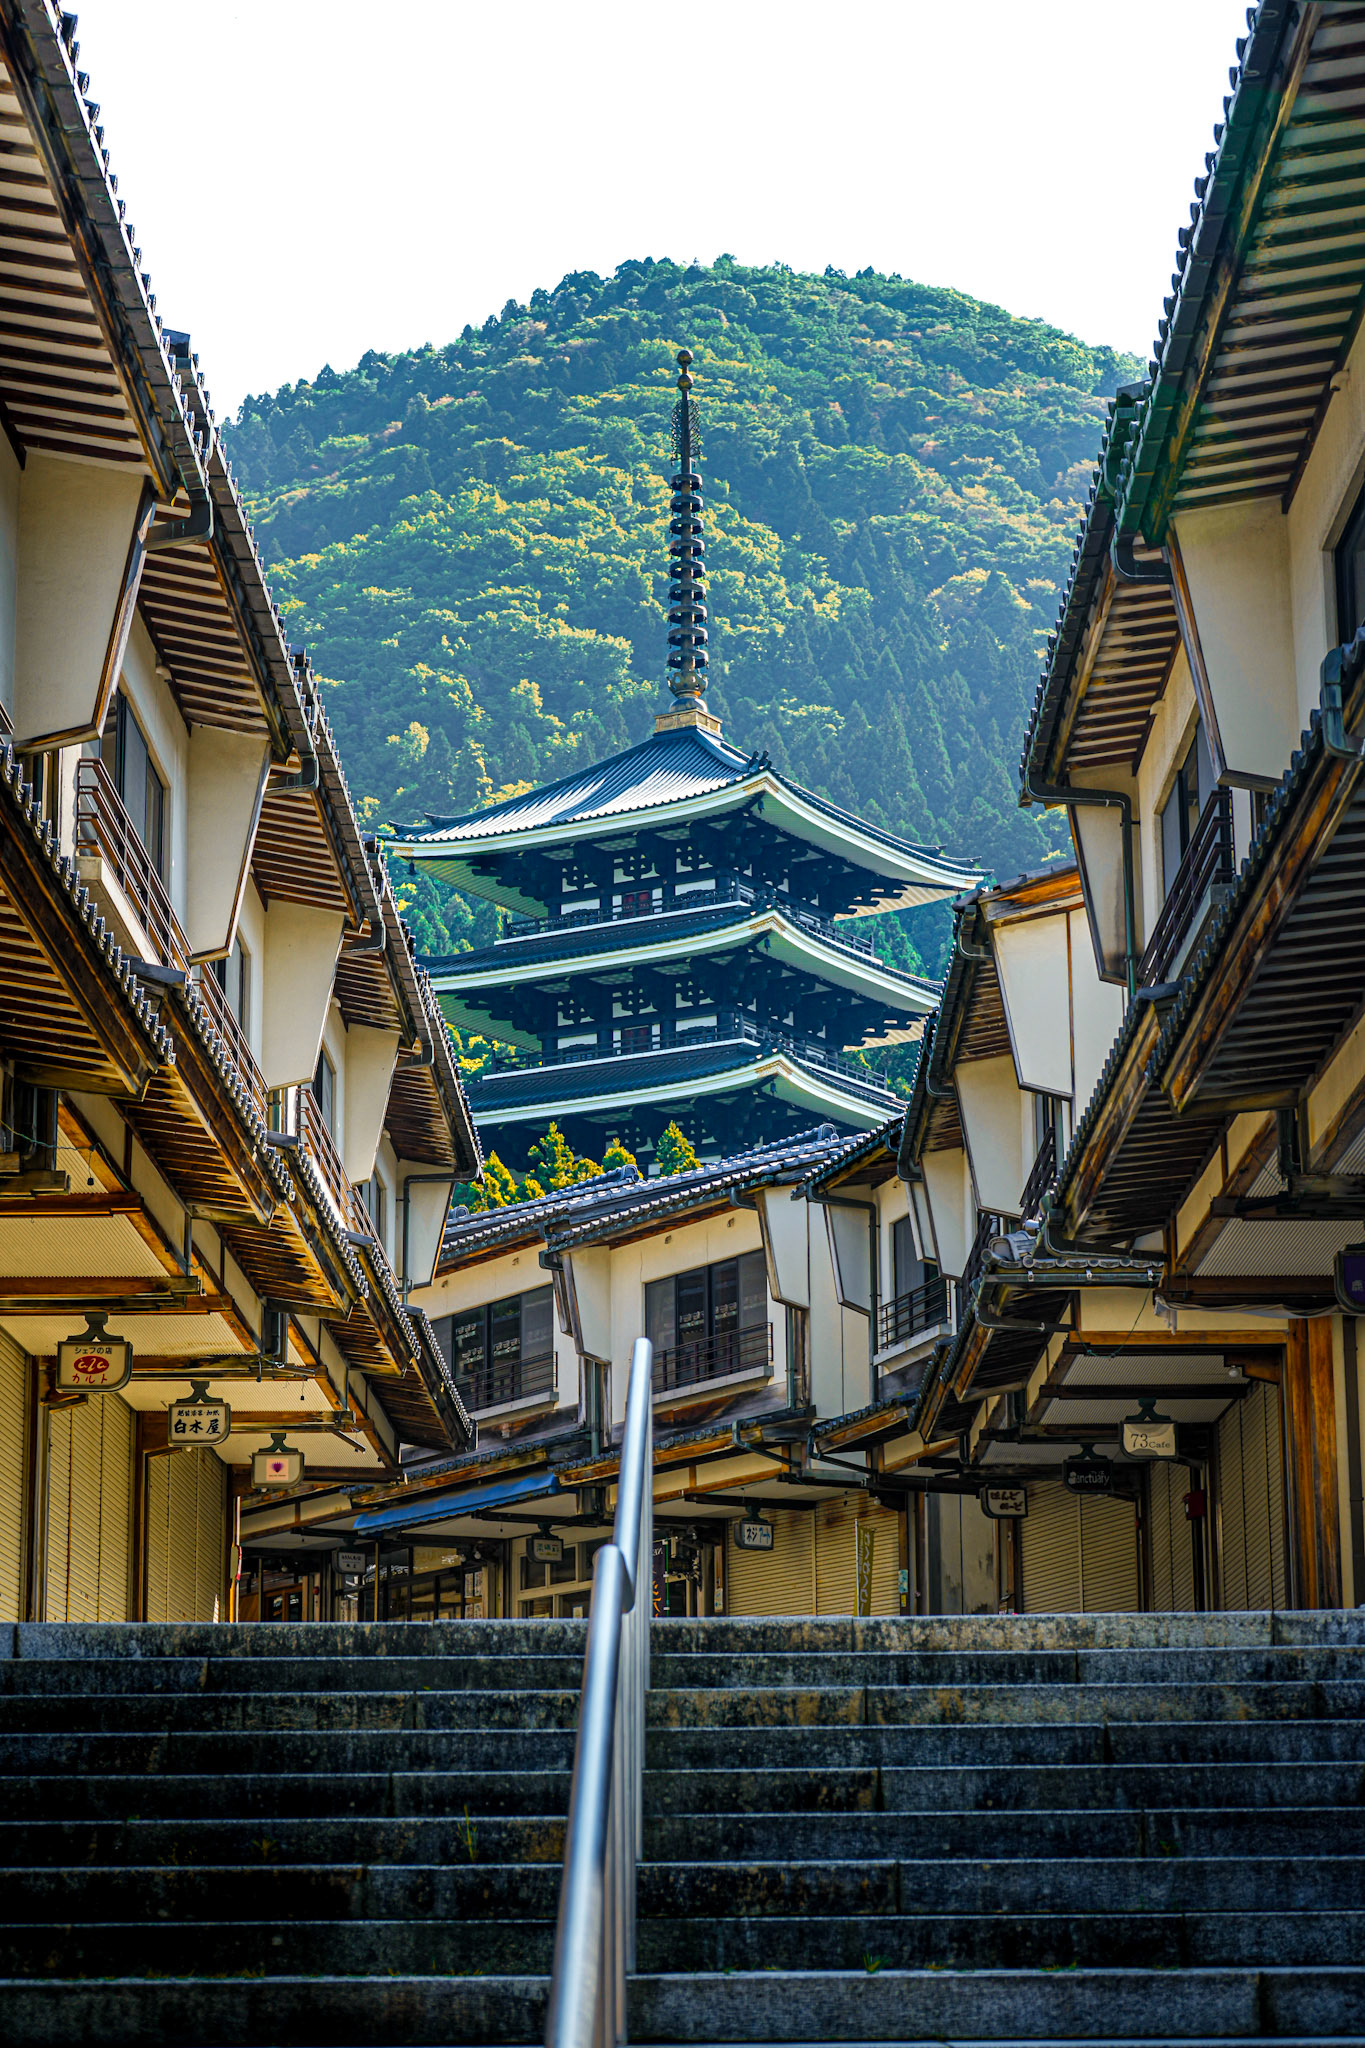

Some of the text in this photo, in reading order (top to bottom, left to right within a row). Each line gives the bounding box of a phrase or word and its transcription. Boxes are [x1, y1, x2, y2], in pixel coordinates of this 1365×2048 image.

[74, 1346, 113, 1355] シェフの店
[72, 1373, 107, 1384] カルト
[174, 1418, 221, 1435] 白木屋
